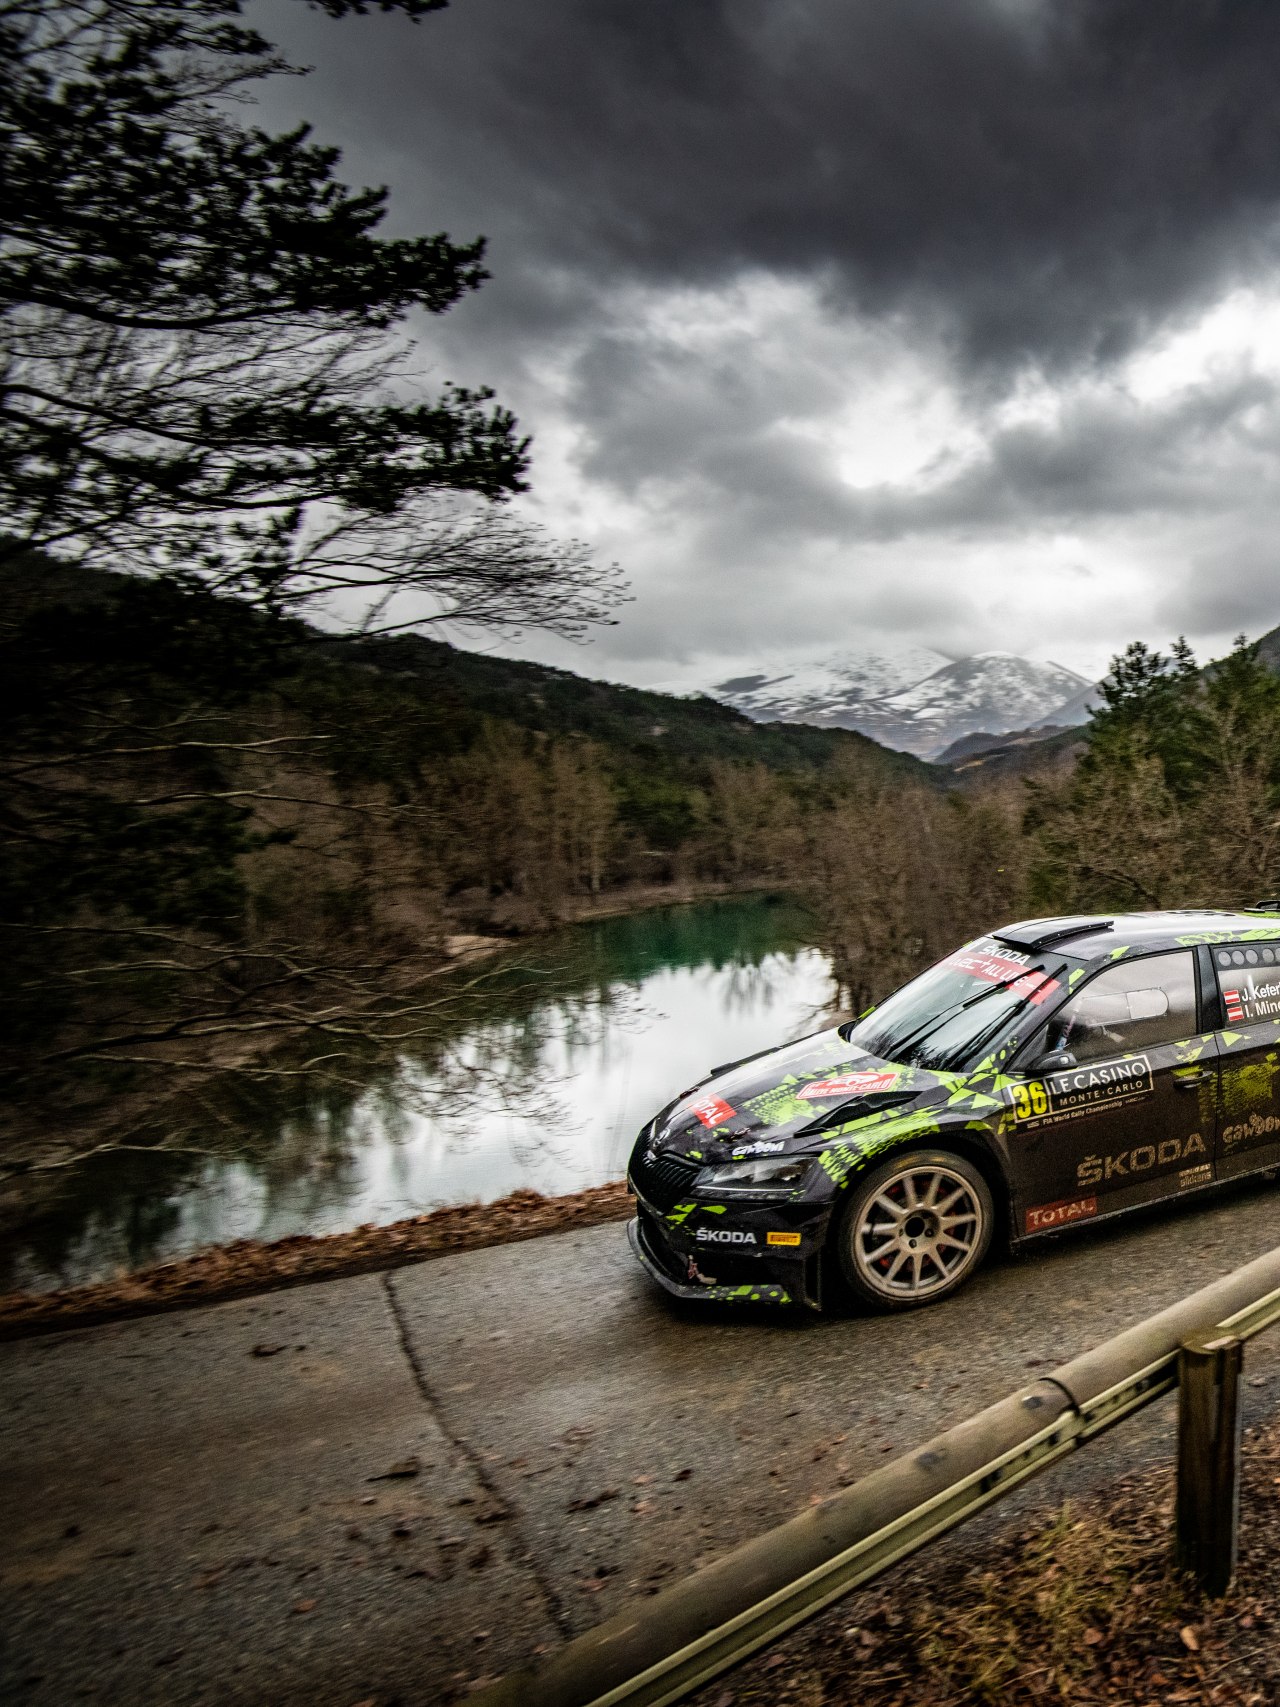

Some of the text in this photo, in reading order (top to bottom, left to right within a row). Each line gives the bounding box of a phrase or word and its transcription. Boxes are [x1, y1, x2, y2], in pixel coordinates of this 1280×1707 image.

[981, 963, 1006, 977] ALL
[1242, 990, 1252, 1002] J.
[1050, 1061, 1147, 1096] LE CASINO
[1012, 1081, 1048, 1119] 36
[1077, 1133, 1207, 1187] ŠKODA
[1029, 1201, 1094, 1226] TOTAL
[696, 1227, 757, 1244] ŠKODA
